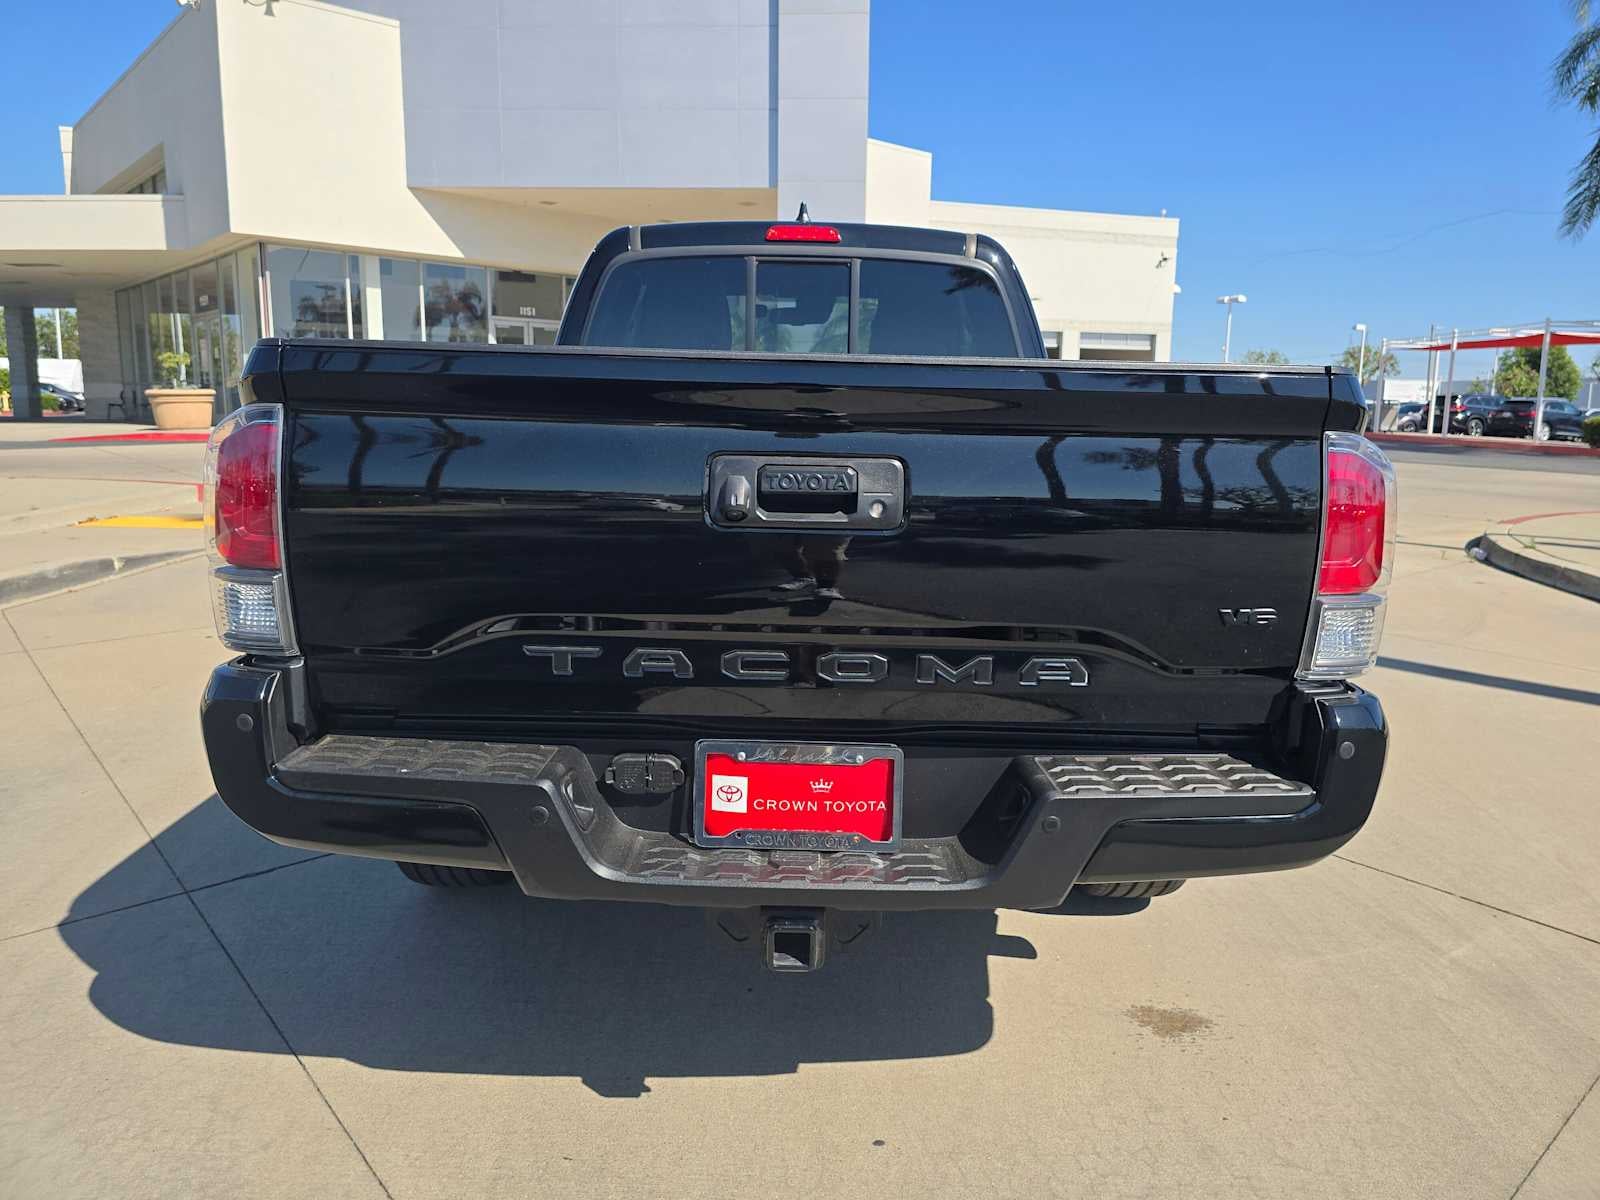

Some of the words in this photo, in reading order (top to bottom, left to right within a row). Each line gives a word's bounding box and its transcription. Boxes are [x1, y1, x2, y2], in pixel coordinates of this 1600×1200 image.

[519, 306, 536, 316] 1151
[766, 472, 849, 491] TOYOTA
[1217, 607, 1279, 625] V6
[523, 645, 1090, 687] TACOMA
[753, 799, 818, 812] CROWN
[824, 800, 887, 813] TOYOTA
[744, 832, 796, 847] CROWN
[799, 834, 851, 849] TOYOTA
